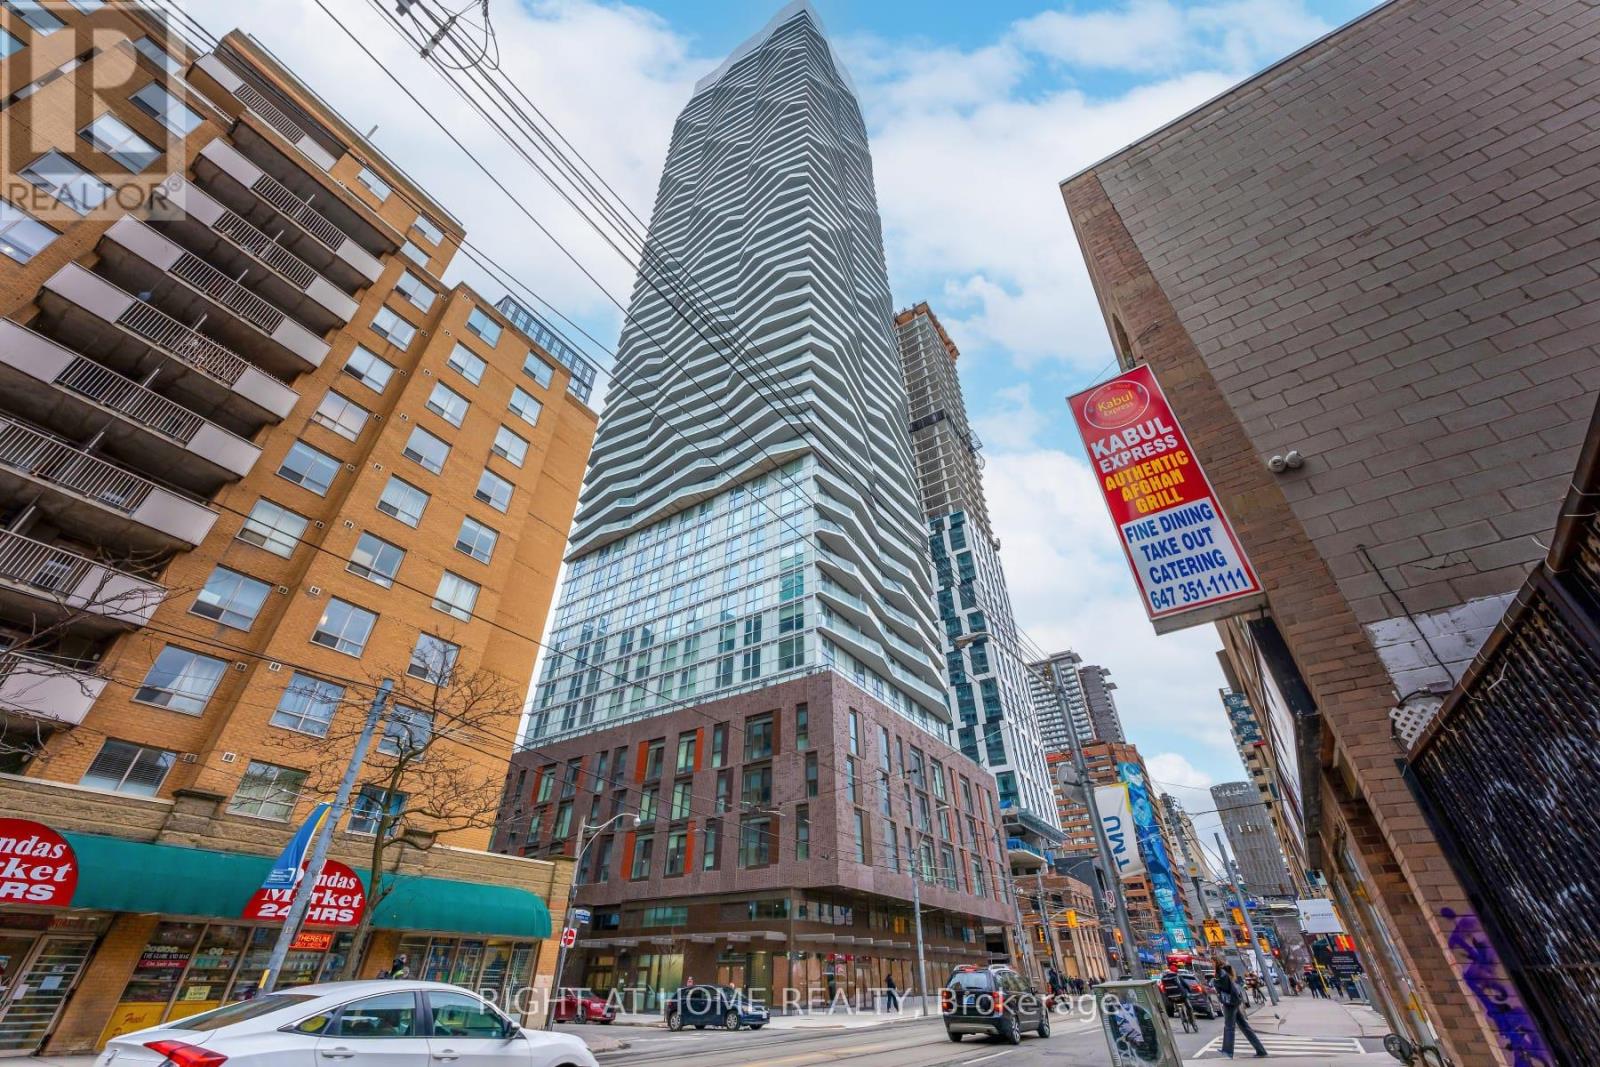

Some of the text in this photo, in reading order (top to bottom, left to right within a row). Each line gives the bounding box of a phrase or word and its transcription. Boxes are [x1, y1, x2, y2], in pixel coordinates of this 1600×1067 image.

[1097, 390, 1133, 411] Kabul
[1090, 417, 1173, 459] KABUL
[1099, 435, 1178, 473] EXPRESS
[1105, 450, 1189, 491] AUTHENTIC
[1121, 468, 1185, 502] AFGHAN
[1135, 487, 1184, 513] GRILL
[1124, 503, 1215, 543] FINE DINING
[1140, 526, 1214, 562] TAKE OUT
[1149, 549, 1227, 584] CATERING
[1150, 568, 1248, 610] 647 351-1111
[1103, 815, 1130, 872] TMU
[261, 889, 362, 908] Mrket
